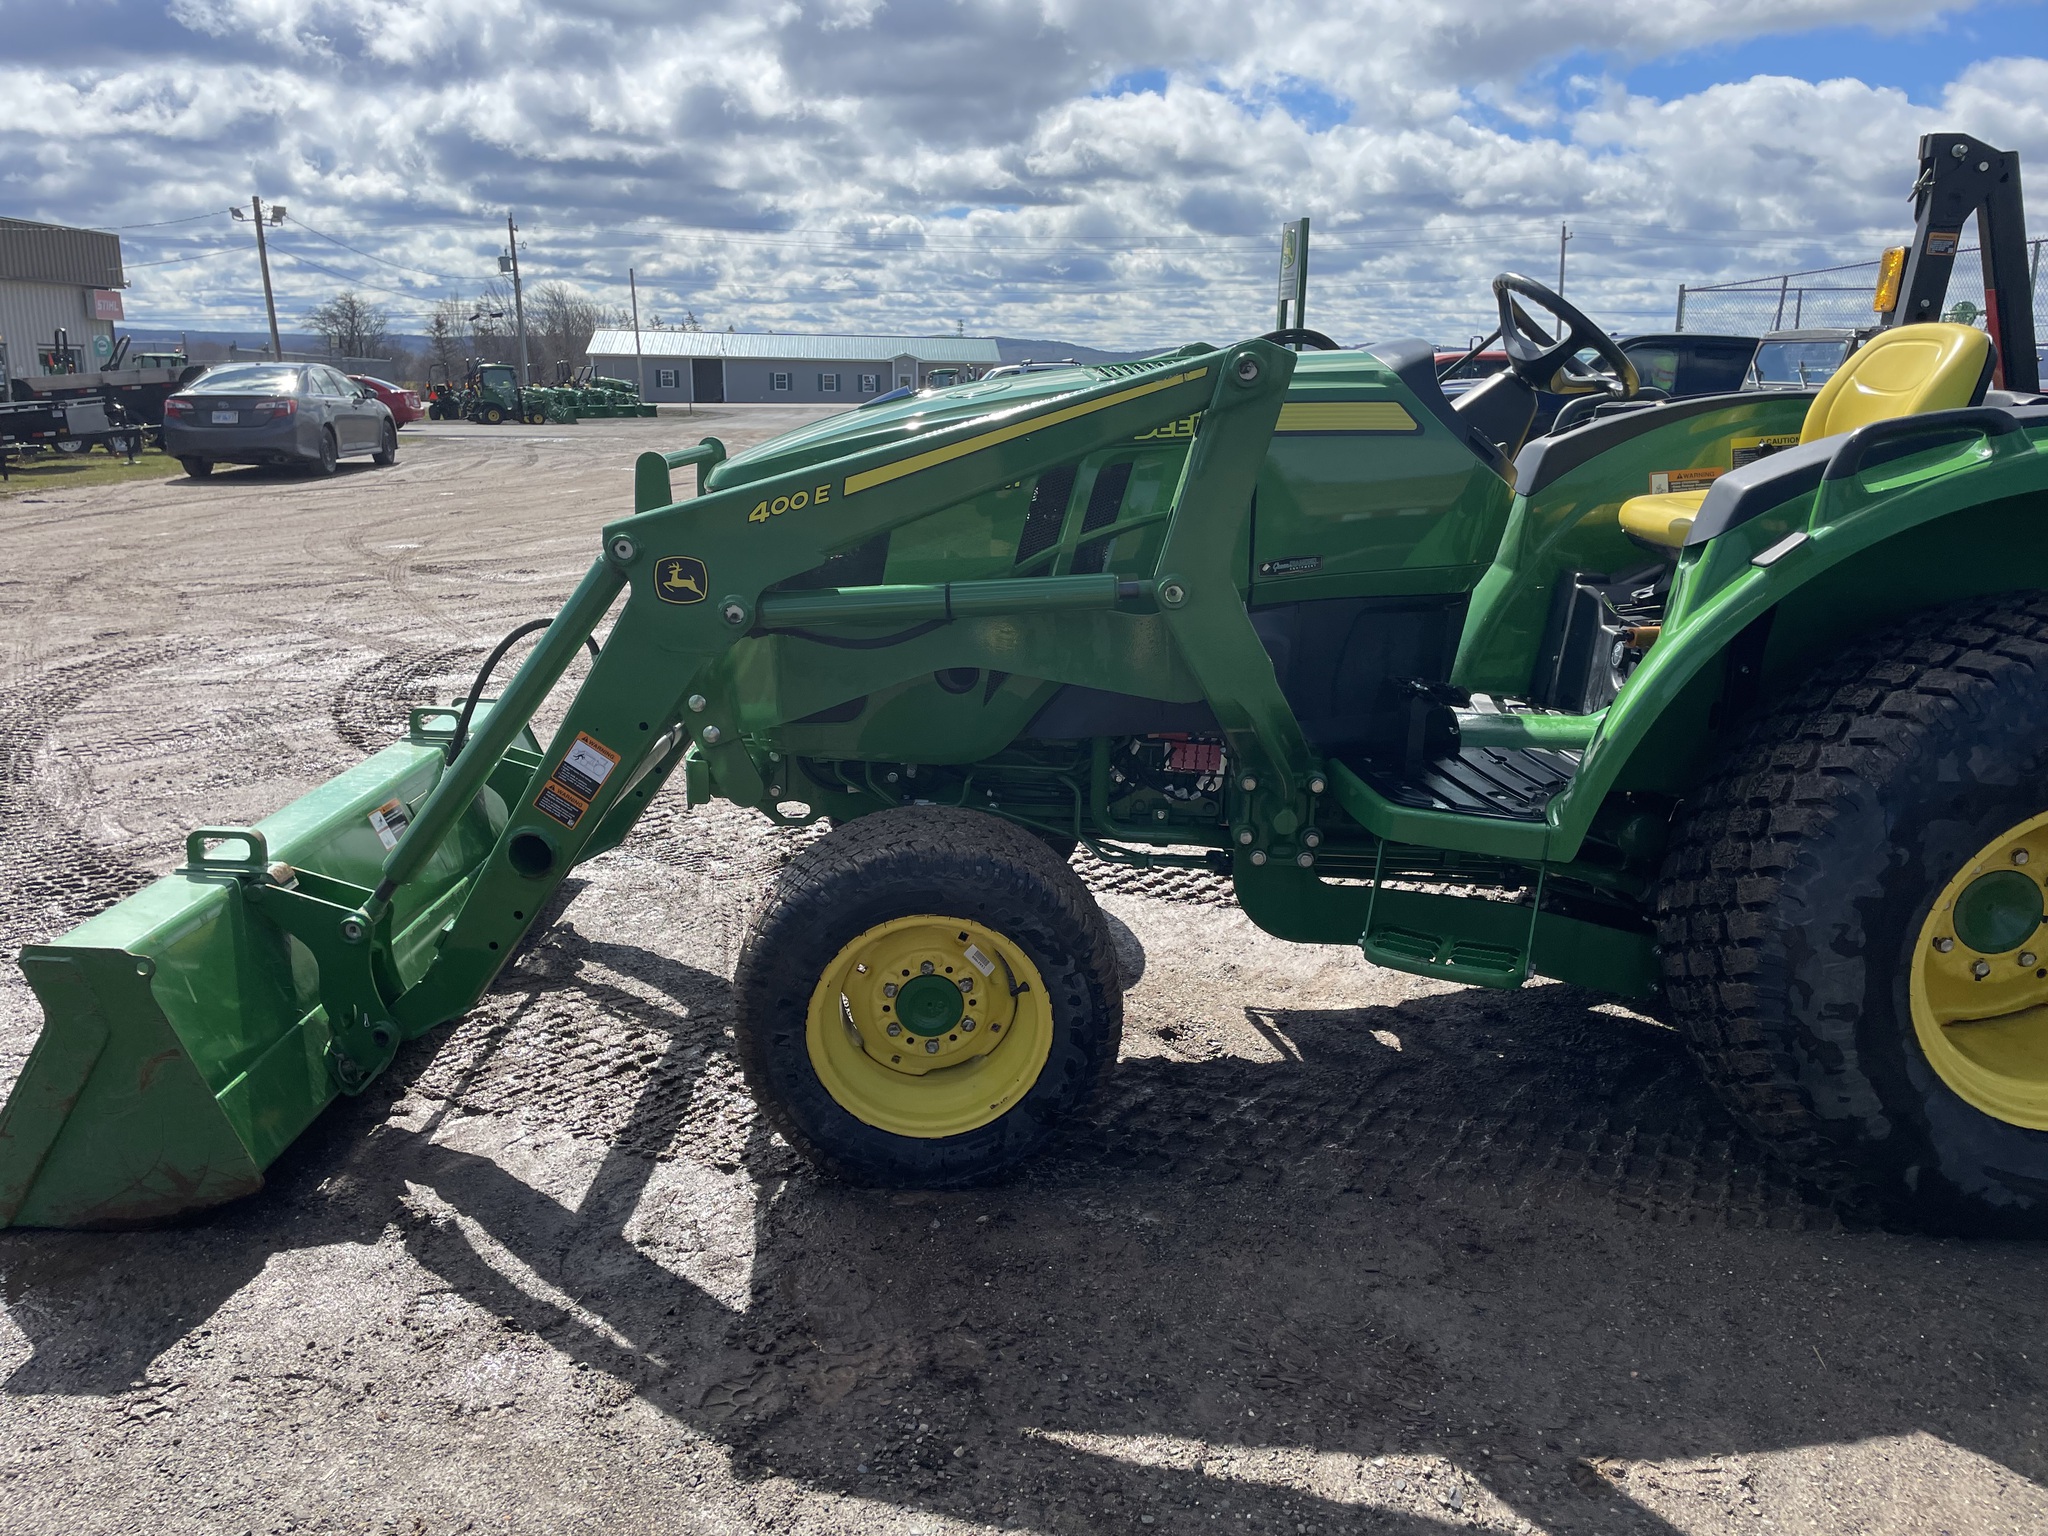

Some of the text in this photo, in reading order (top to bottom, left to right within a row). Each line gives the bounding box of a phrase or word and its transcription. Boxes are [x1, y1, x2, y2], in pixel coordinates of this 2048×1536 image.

[97, 300, 119, 312] STIHL
[1682, 471, 1715, 479] WARNING
[748, 483, 832, 523] 400 E
[588, 740, 615, 760] WARNING
[557, 788, 583, 808] WARNING
